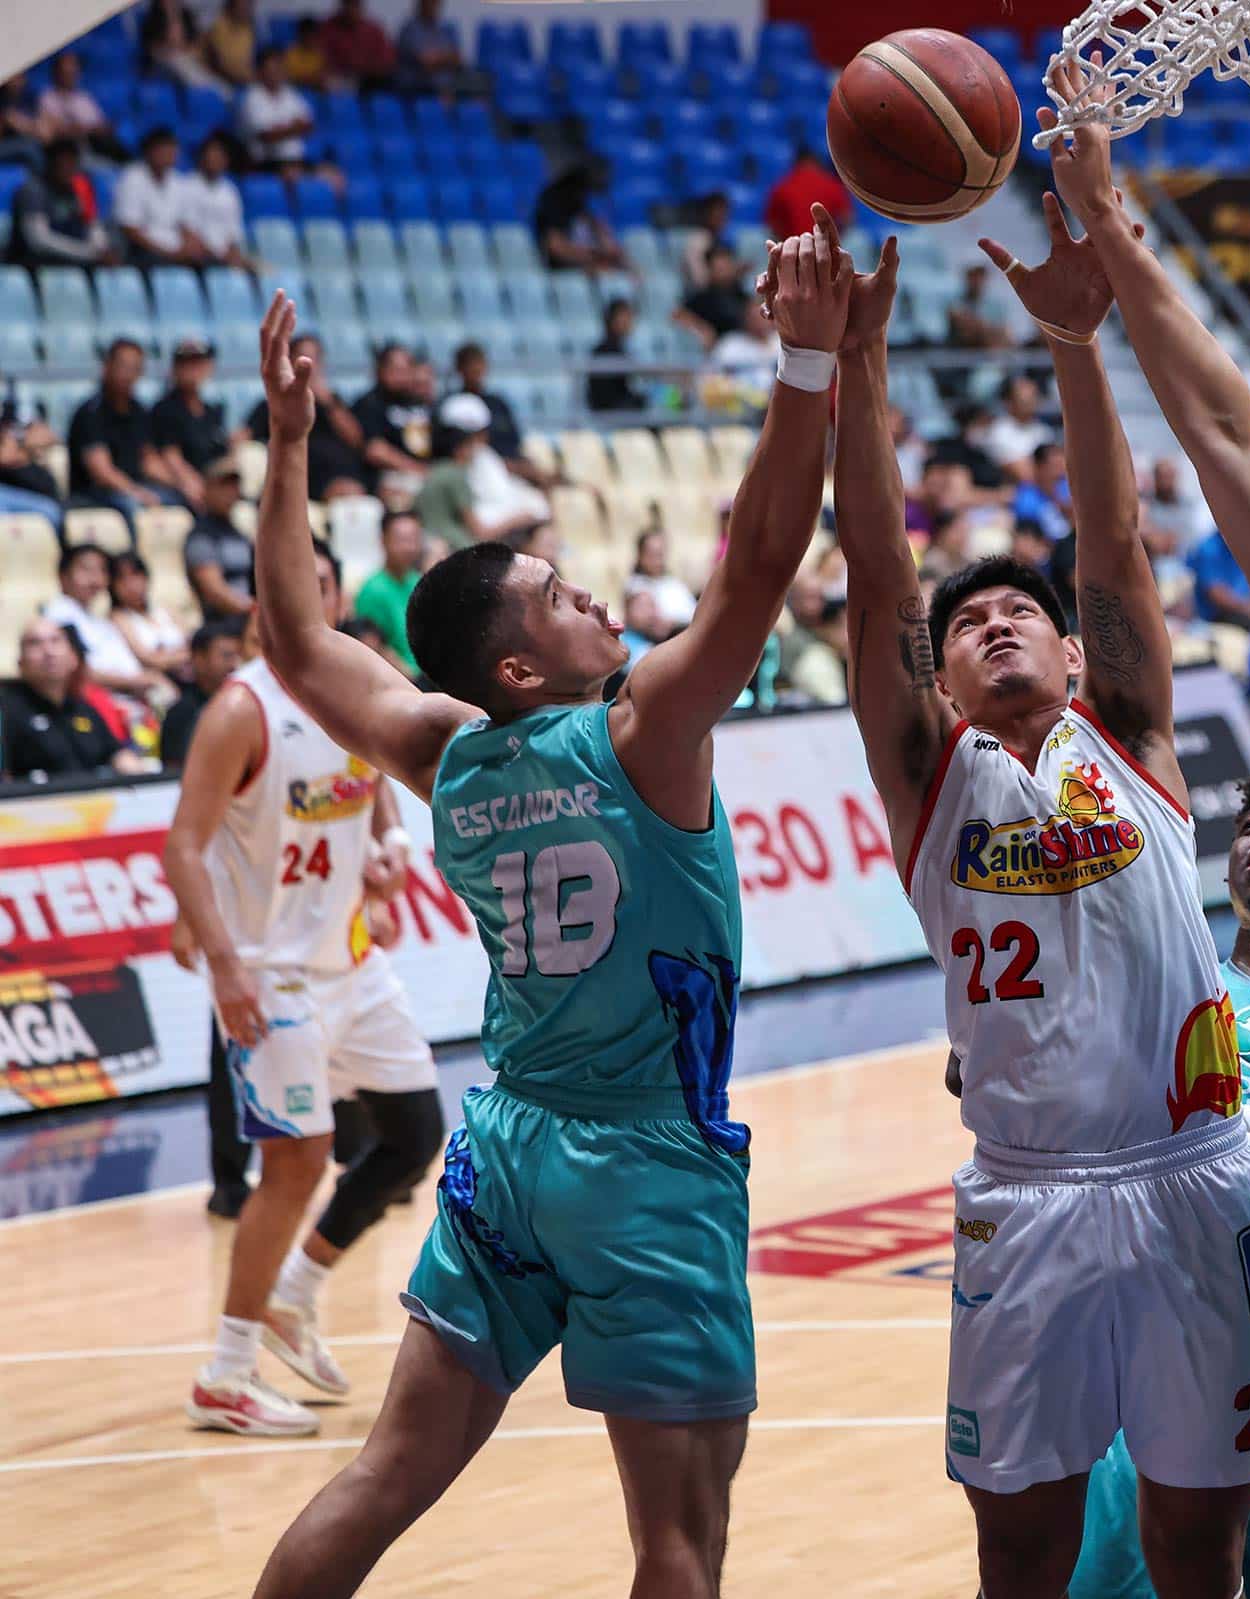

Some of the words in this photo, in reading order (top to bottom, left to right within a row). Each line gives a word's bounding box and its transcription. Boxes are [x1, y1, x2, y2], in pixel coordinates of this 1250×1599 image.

[450, 782, 602, 839] ESCANDOR
[281, 836, 333, 886] 24
[956, 822, 1040, 883] Rain
[996, 872, 1057, 889] ELASTO
[951, 920, 1045, 1005] 22
